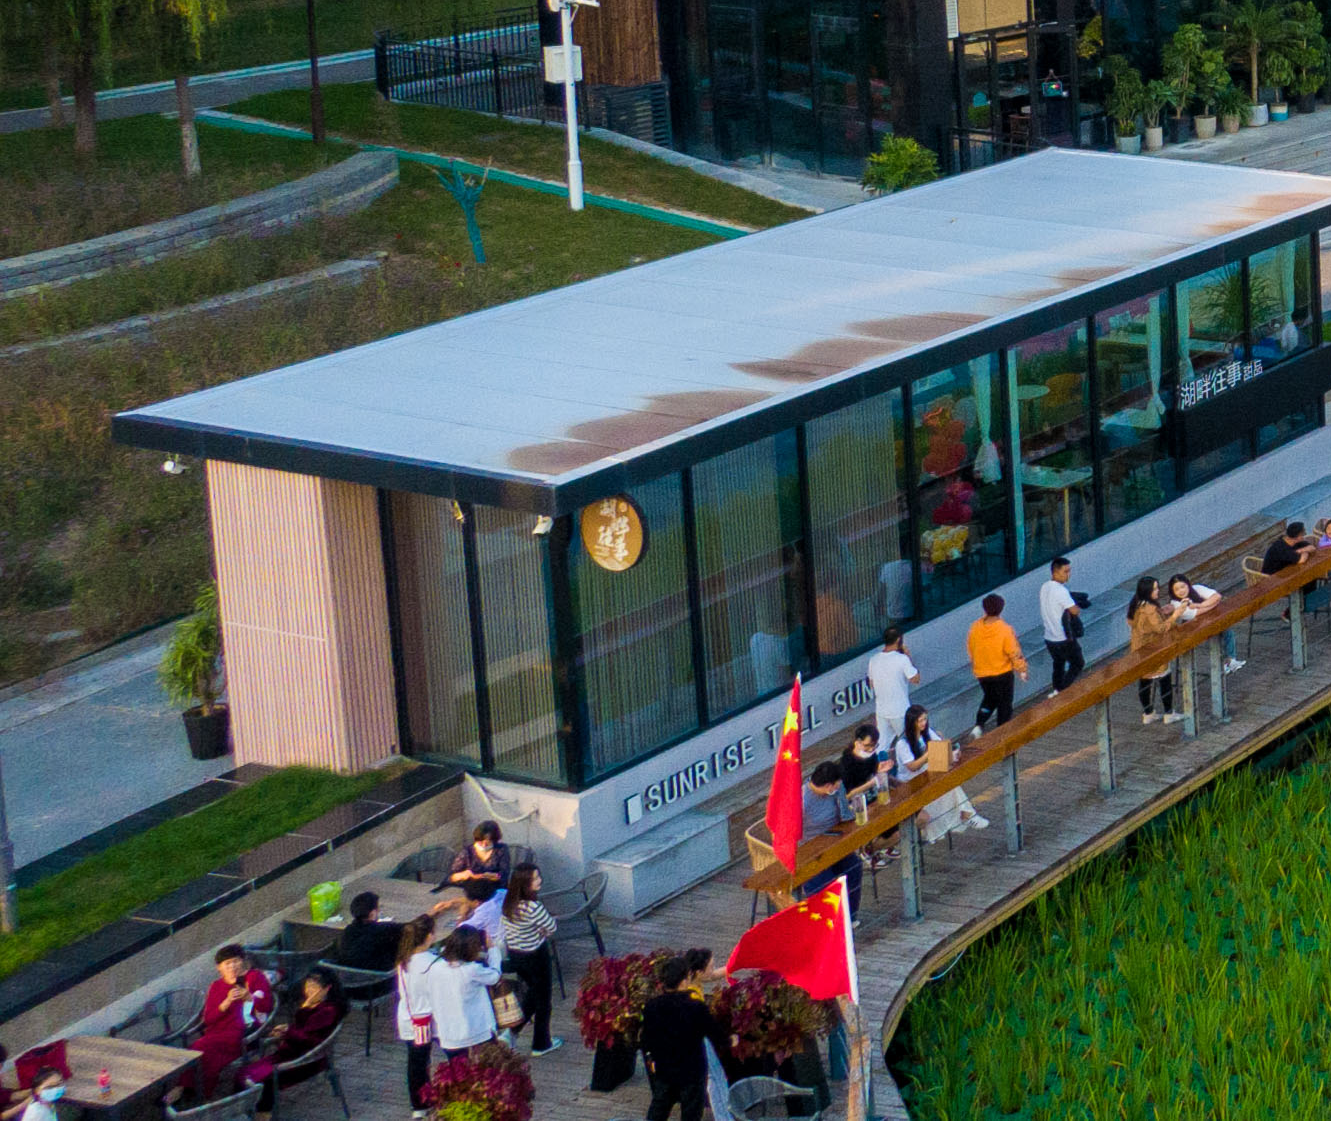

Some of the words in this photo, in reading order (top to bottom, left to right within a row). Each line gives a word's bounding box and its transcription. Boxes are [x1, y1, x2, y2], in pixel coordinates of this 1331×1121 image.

[1180, 360, 1242, 411] 湖畔往事
[645, 736, 755, 813] SUNRISE
[766, 705, 824, 750] TL
[833, 675, 876, 716] SUN
